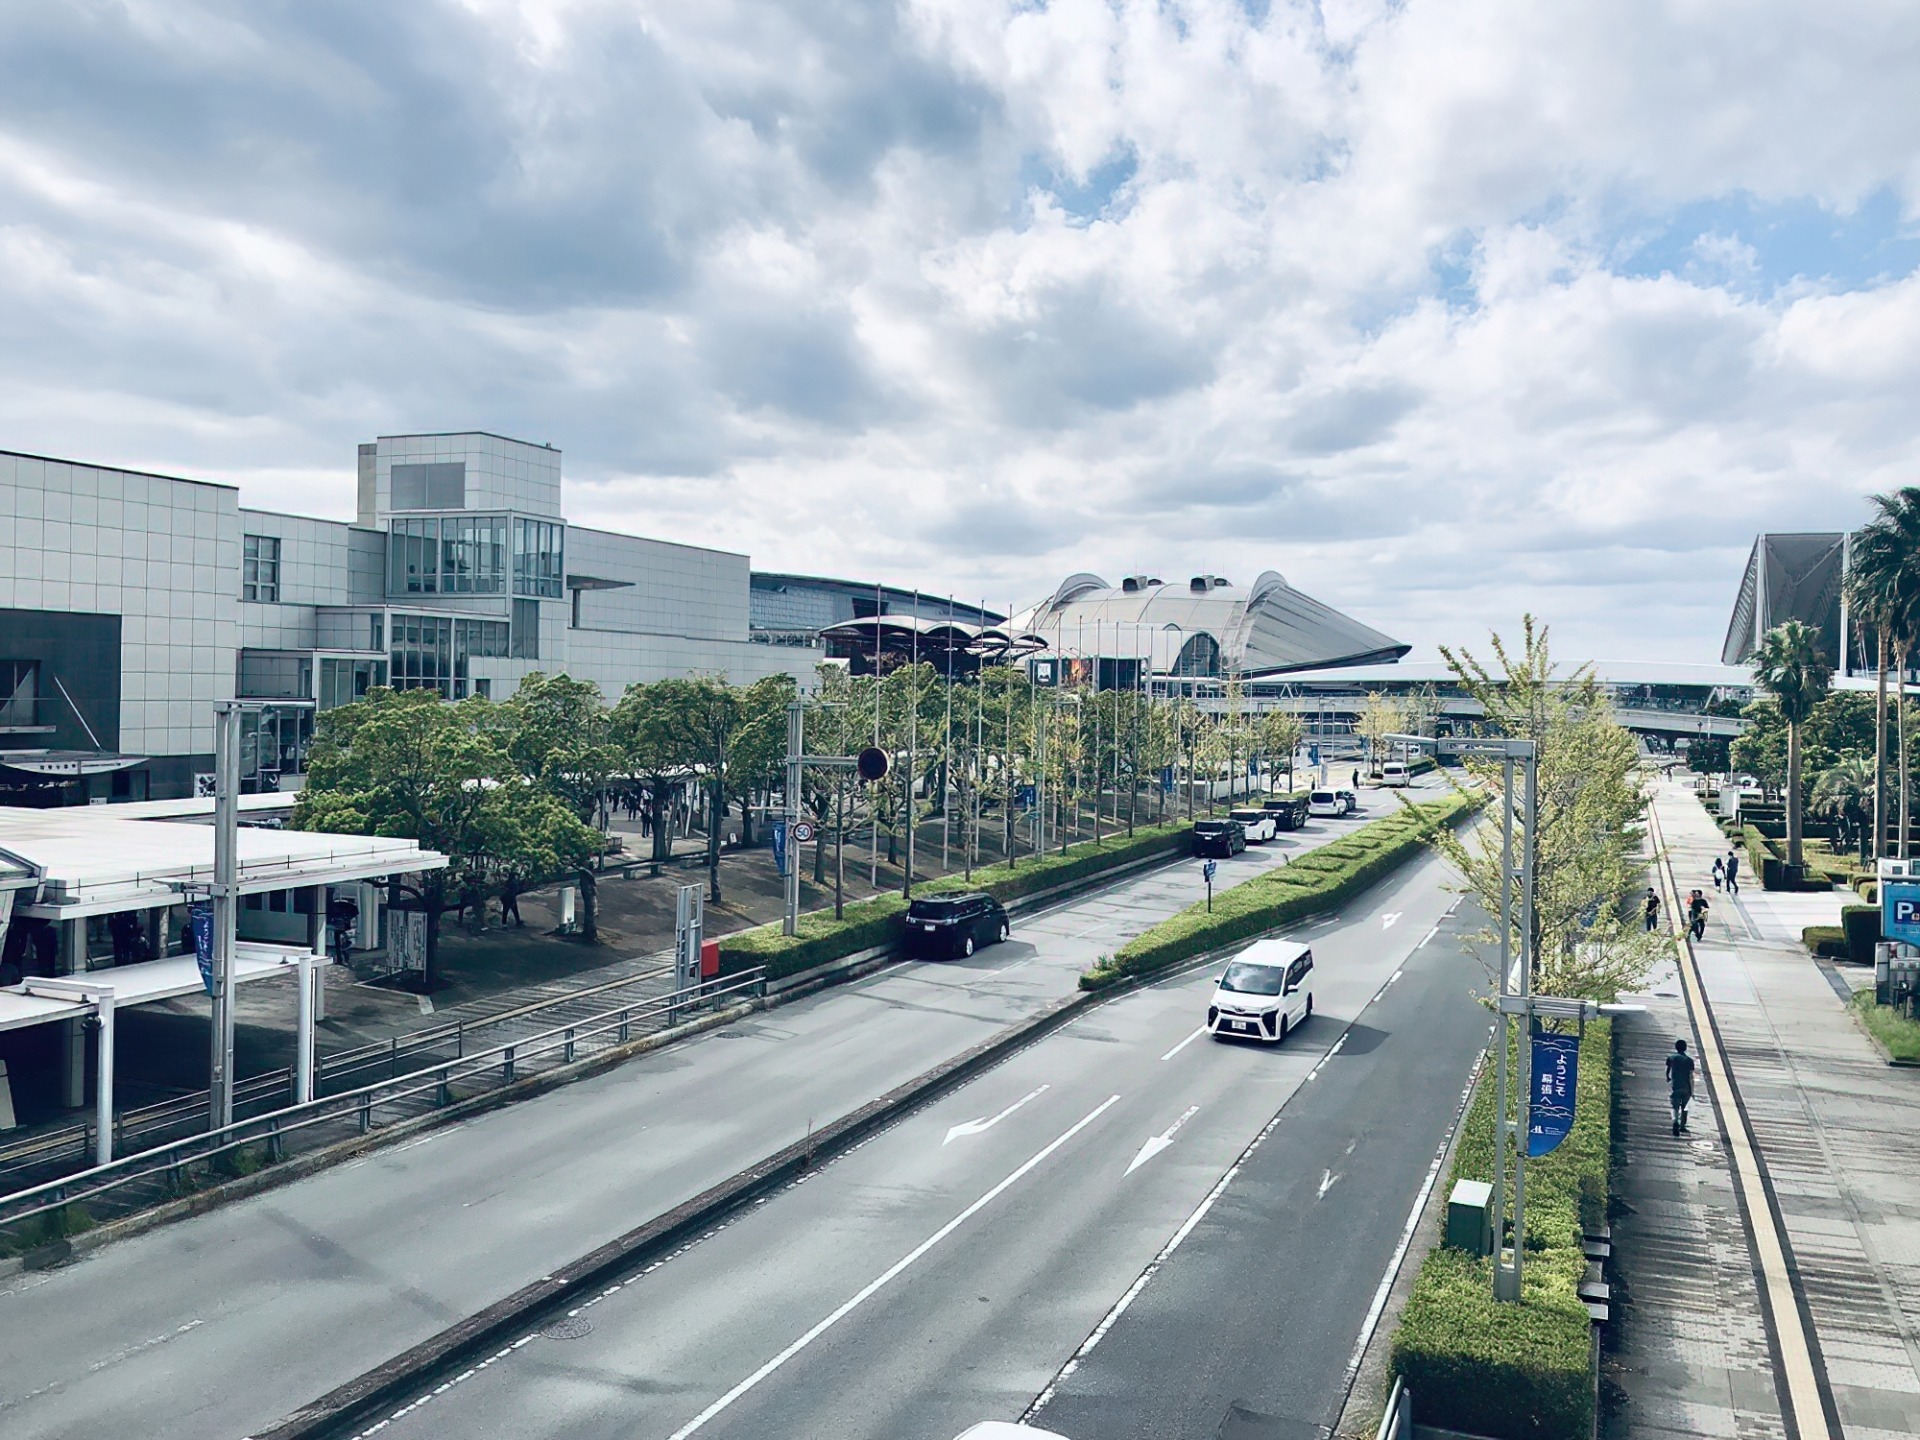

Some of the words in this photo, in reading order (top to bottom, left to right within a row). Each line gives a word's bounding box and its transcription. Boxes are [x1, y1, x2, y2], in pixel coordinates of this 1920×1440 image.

[796, 826, 810, 838] 50
[1897, 902, 1914, 920] P
[1555, 1054, 1568, 1097] ようこそ
